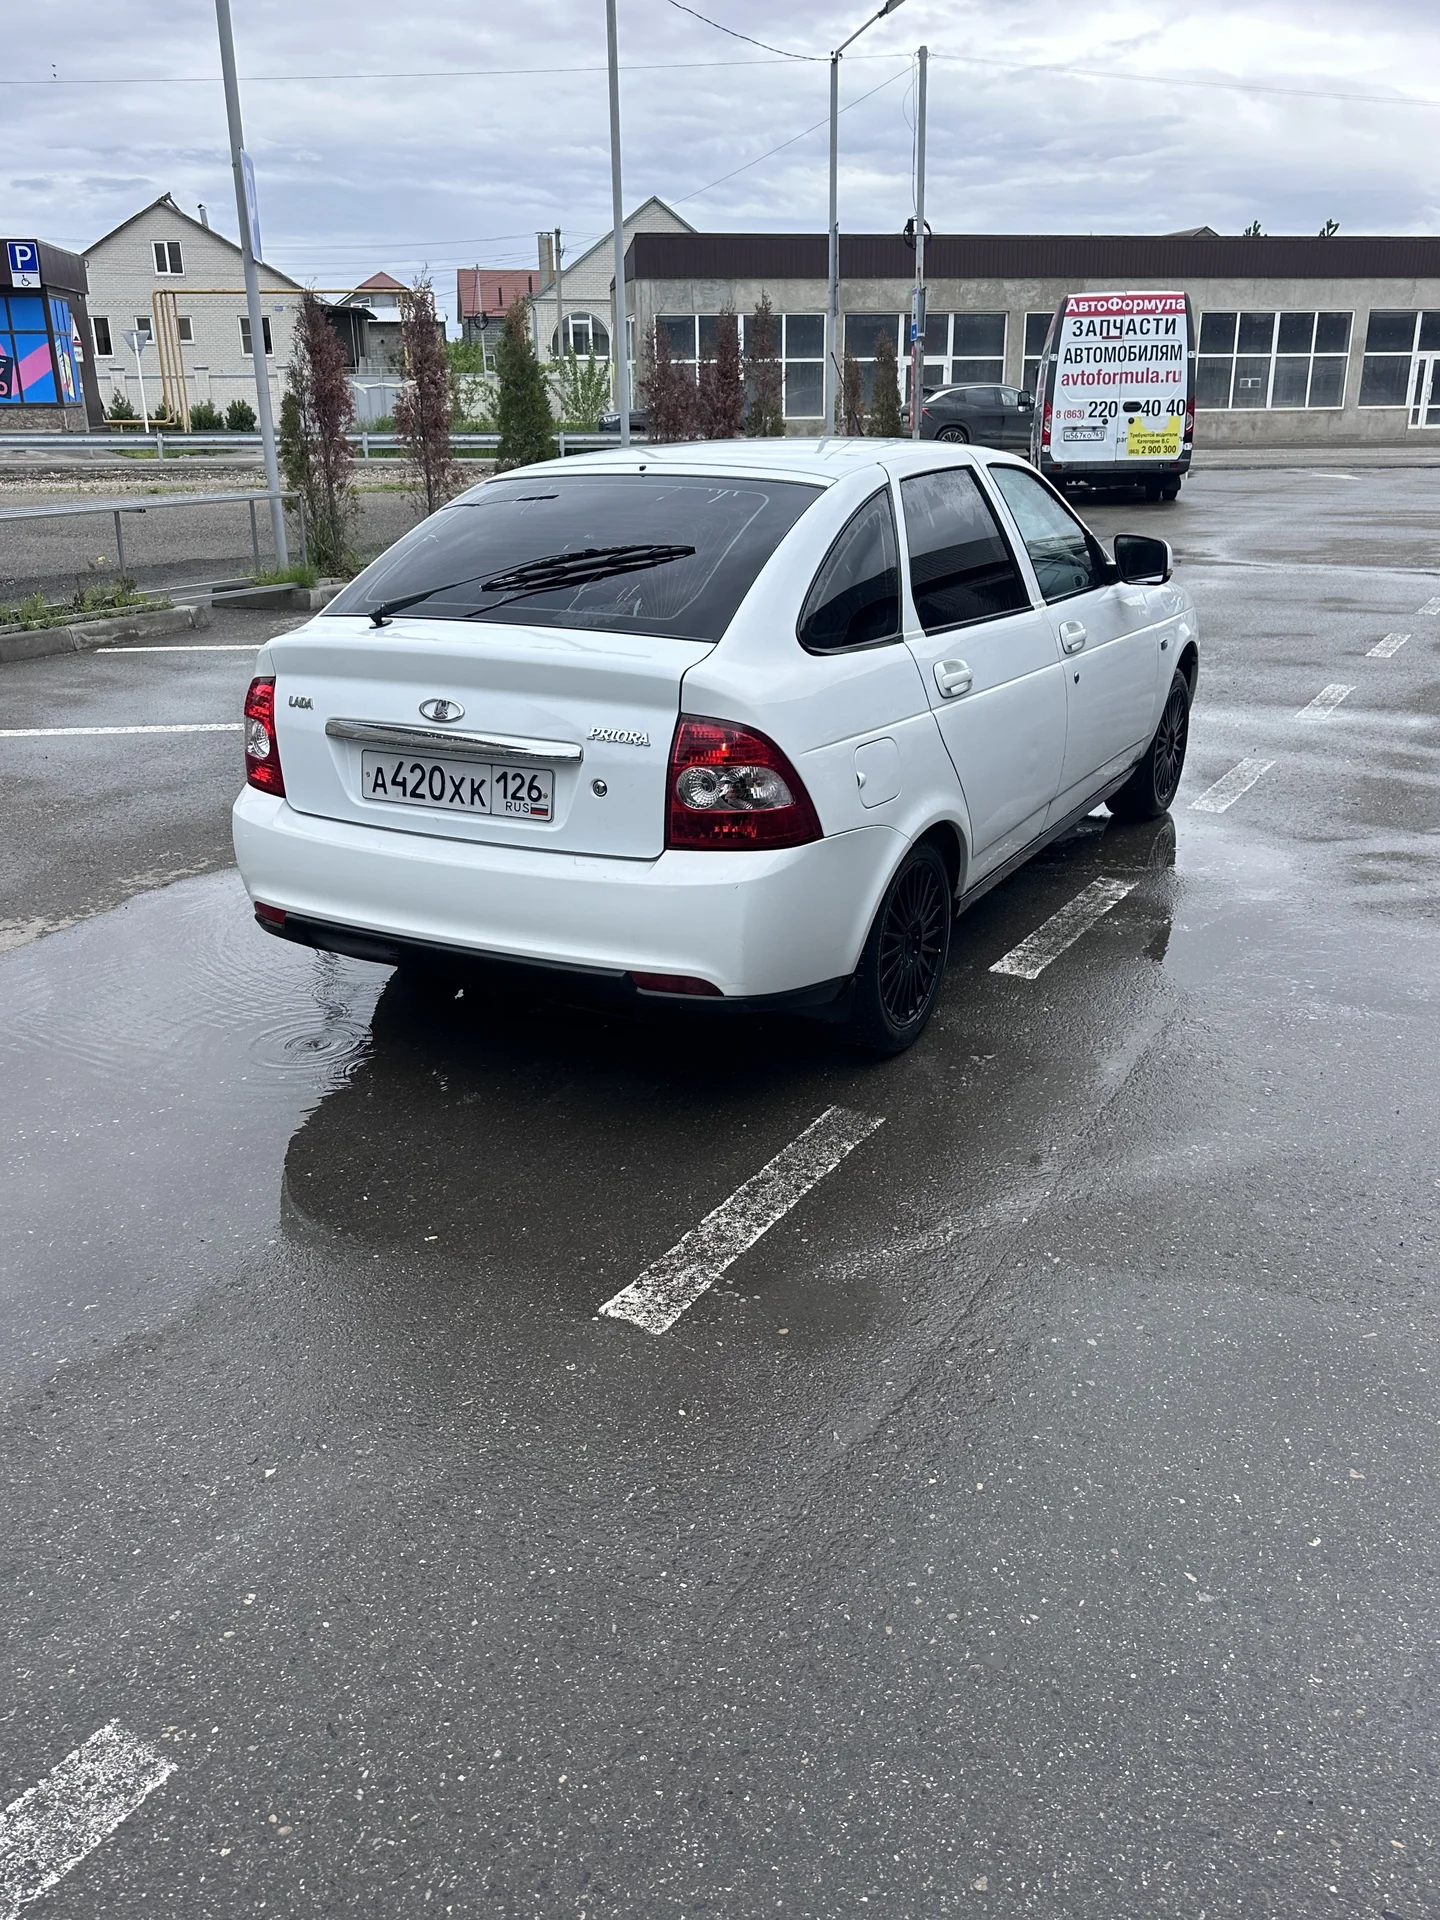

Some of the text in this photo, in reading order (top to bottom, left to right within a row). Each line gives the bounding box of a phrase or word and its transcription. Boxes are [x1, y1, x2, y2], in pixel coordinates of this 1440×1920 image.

[15, 246, 31, 268] P
[1066, 297, 1186, 313] АвтоФормула
[1072, 318, 1177, 337] ЗАПЧАСТИ
[1063, 344, 1183, 365] АВТОМОБИЛЯМ
[1061, 367, 1182, 387] avtoformula.ru
[1055, 399, 1186, 420] 8 (863) 220 40 40
[1141, 446, 1147, 454] 2
[1148, 445, 1162, 454] 900
[1163, 445, 1177, 454] 300
[288, 695, 314, 710] LADA
[586, 726, 651, 748] PRIORA
[371, 761, 542, 807] А420ХК 126
[505, 800, 531, 814] RUS
